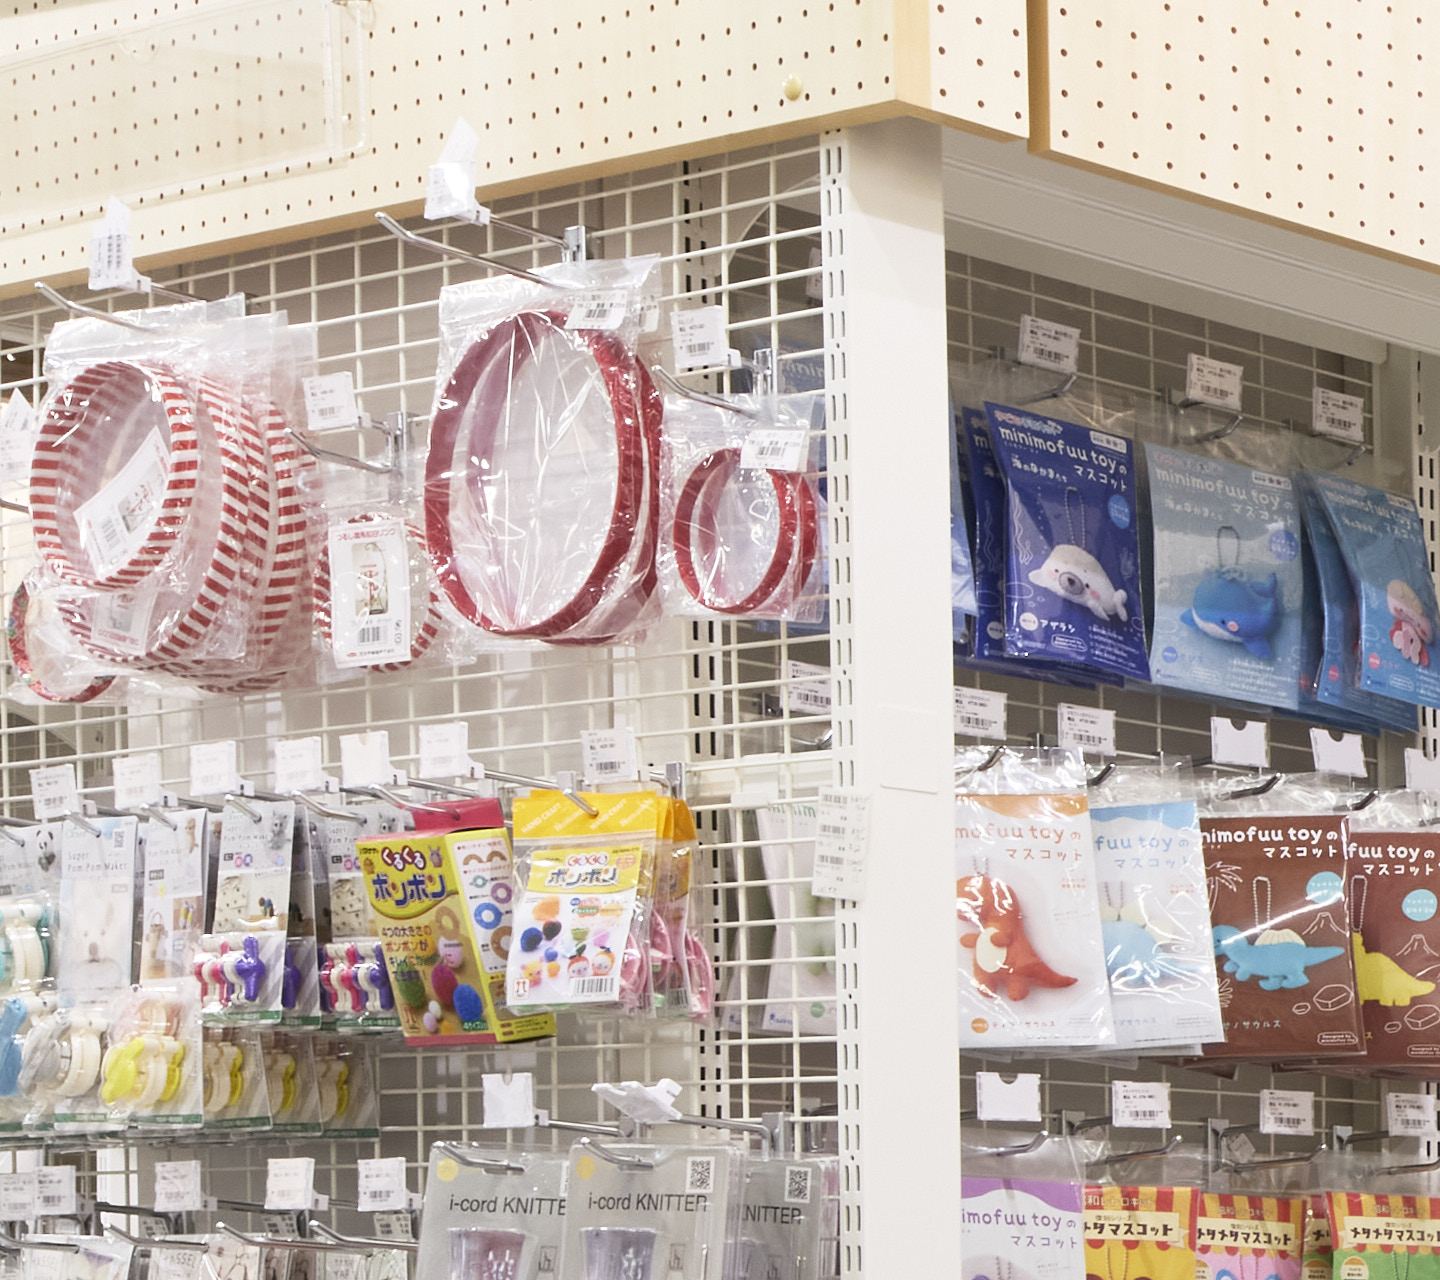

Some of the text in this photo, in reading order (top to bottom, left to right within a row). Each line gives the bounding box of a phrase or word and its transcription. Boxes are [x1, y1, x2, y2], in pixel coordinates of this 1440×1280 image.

[1000, 426, 1116, 473] minimofuu toy
[1074, 465, 1127, 492] マスコット
[1289, 826, 1322, 845] toy
[382, 846, 425, 870] くるくる
[1264, 846, 1337, 859] マスコット
[448, 1194, 566, 1216] i-cord KNITTE
[588, 1191, 707, 1213] i-cord KNITTER
